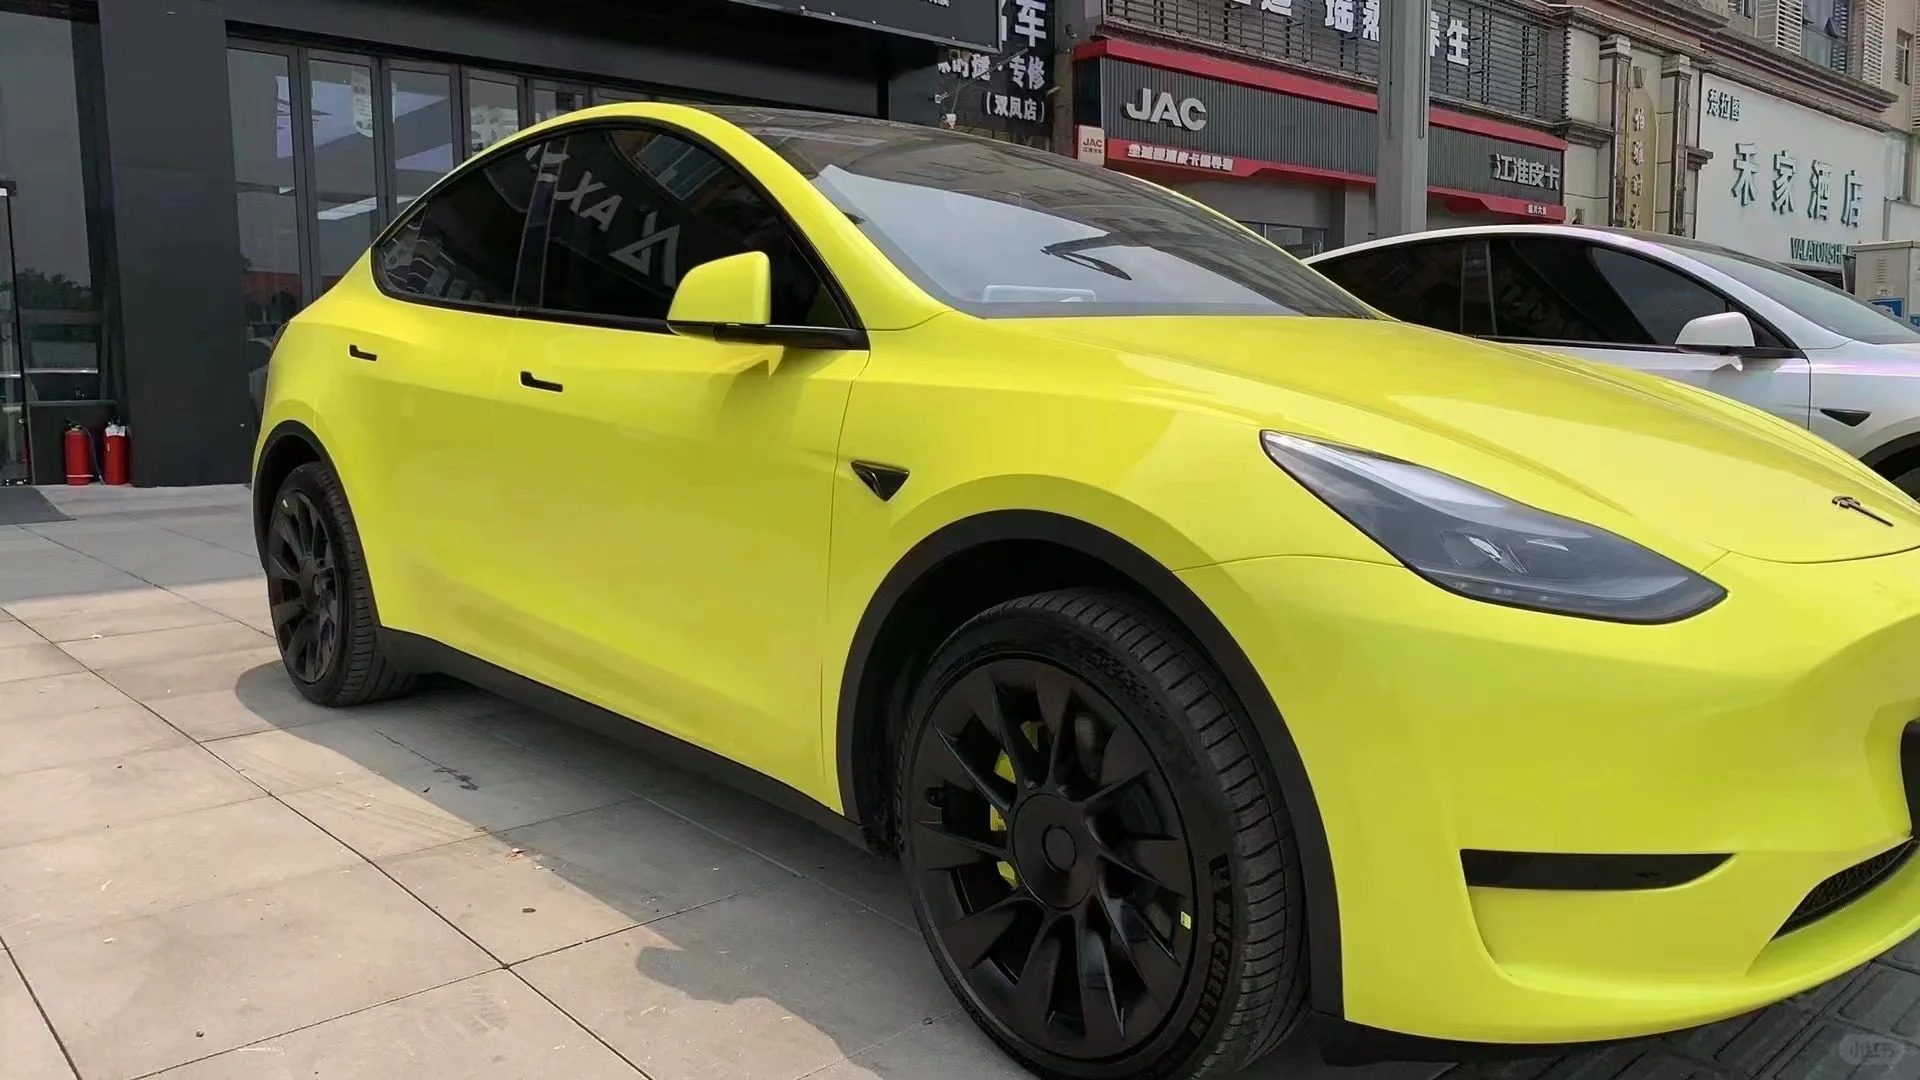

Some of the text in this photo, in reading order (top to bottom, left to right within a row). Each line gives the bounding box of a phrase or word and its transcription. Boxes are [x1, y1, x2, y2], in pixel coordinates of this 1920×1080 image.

[1126, 87, 1208, 131] JAC
[1083, 137, 1103, 148] JAC
[1495, 153, 1560, 190] 江淮皮卡
[1731, 142, 1865, 228] 禾家酒店
